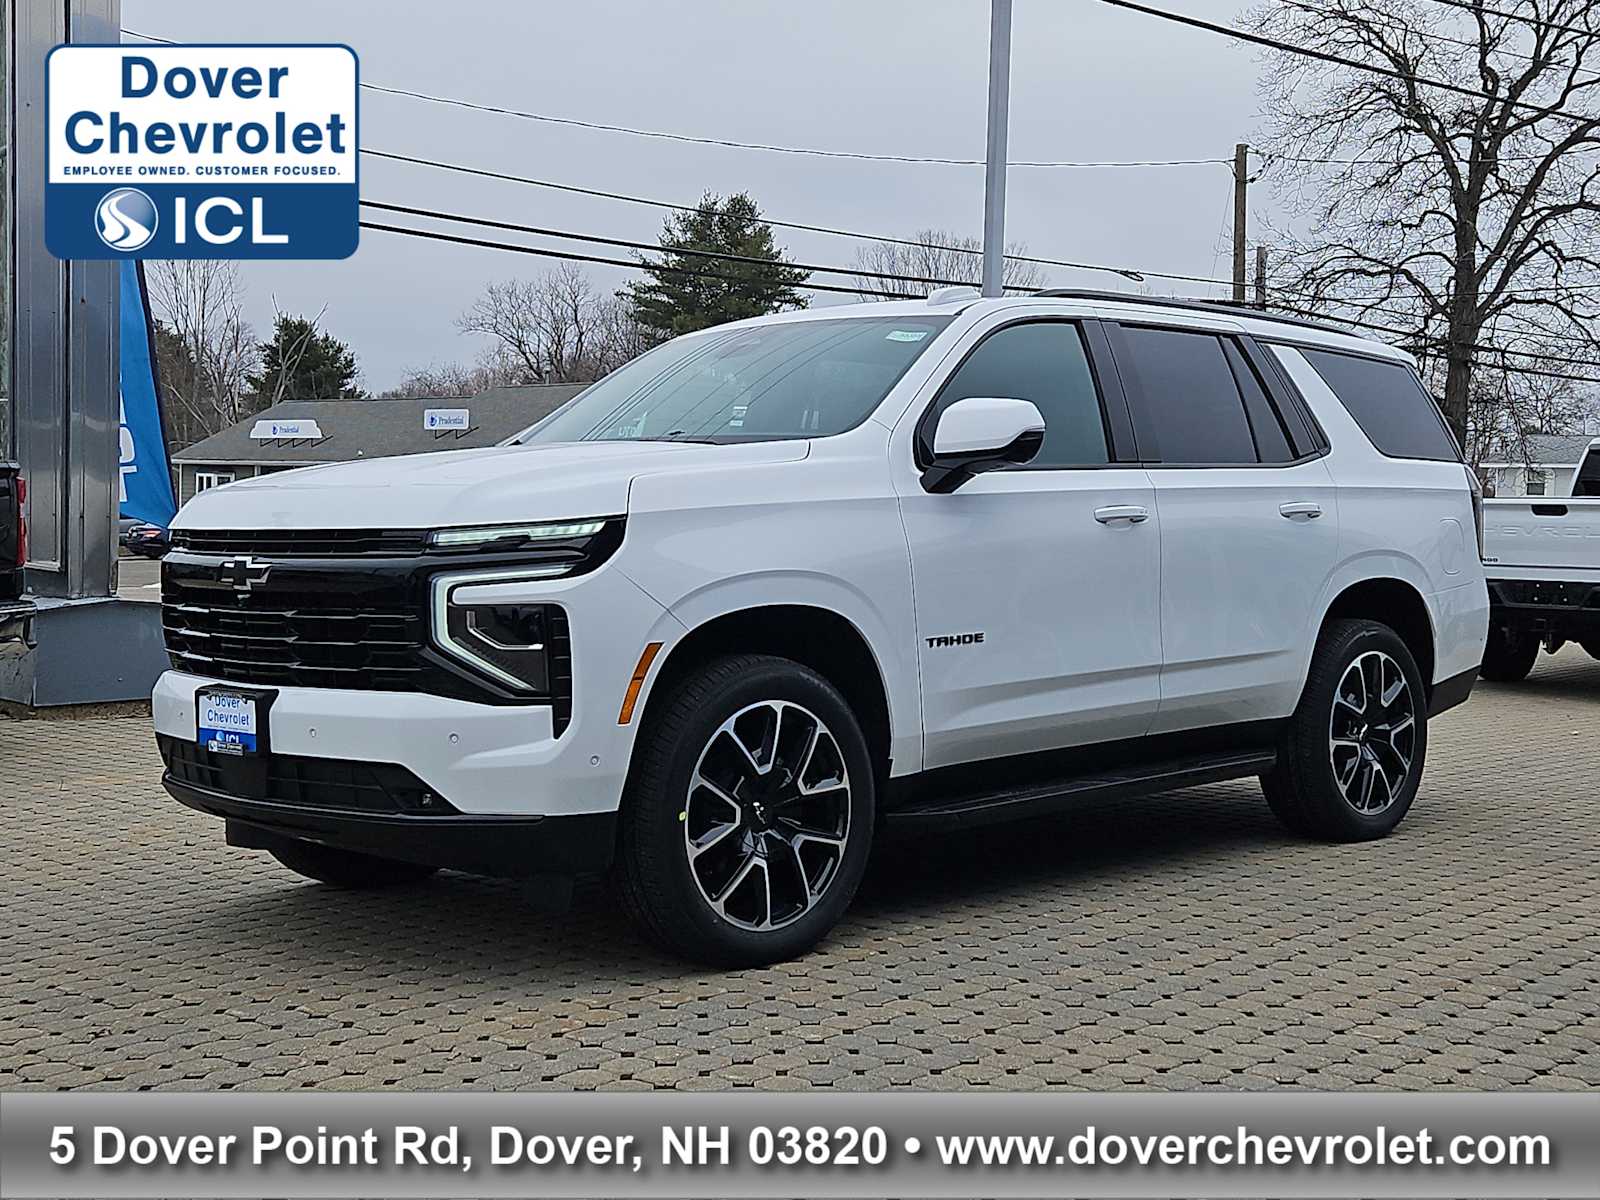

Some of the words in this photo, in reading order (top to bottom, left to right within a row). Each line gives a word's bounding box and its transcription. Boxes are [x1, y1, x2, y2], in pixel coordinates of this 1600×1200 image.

[925, 632, 985, 648] TAHOE
[215, 695, 240, 708] Dover
[208, 709, 249, 726] Chevrolet
